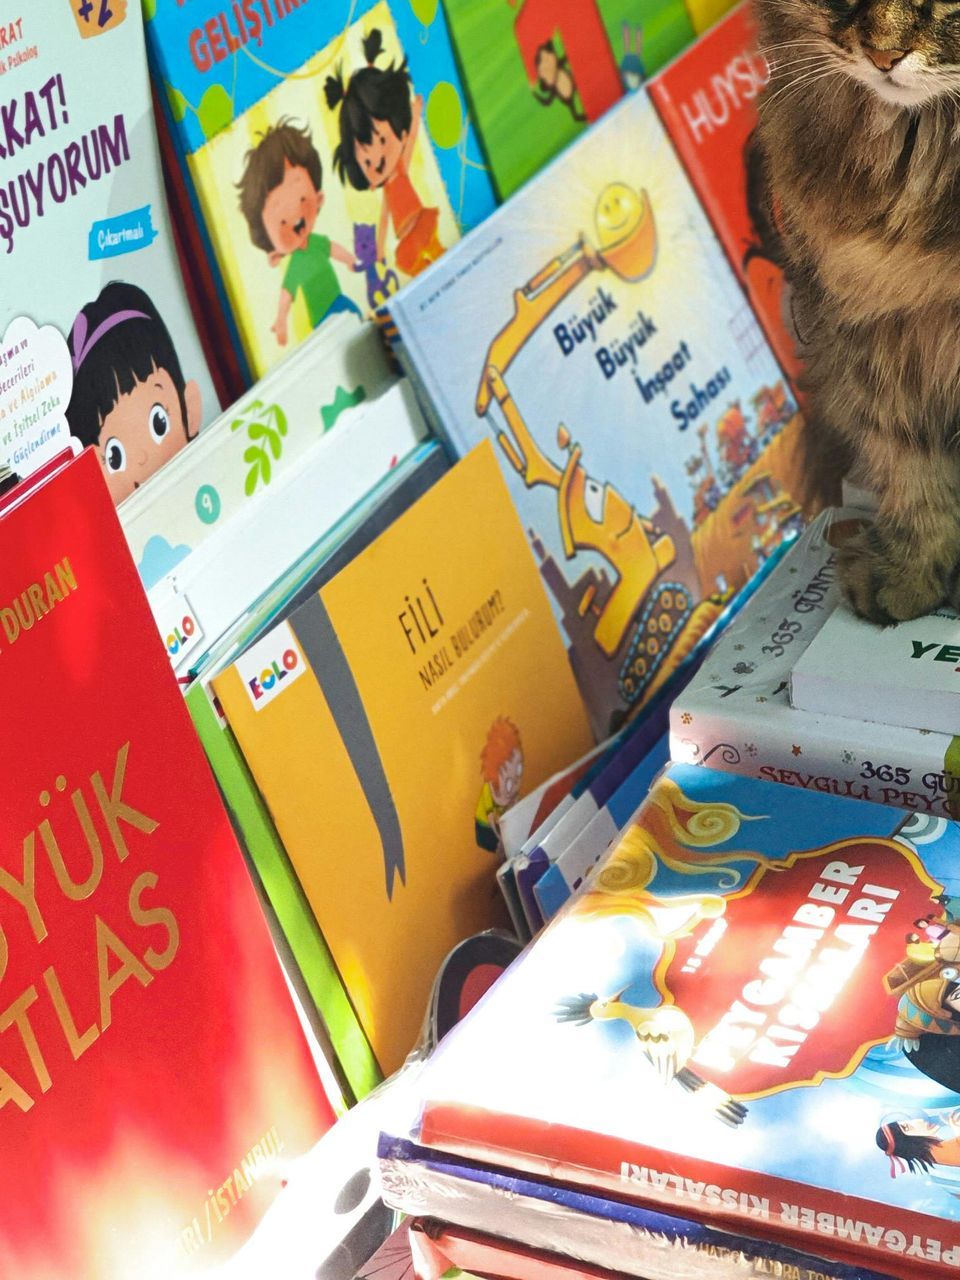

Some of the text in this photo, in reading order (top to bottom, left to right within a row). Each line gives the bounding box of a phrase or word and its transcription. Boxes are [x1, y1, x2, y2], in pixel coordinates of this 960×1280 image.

[98, 223, 144, 251] Çıkartmalı
[553, 286, 617, 357] Büyük
[595, 310, 658, 381] Büyük
[631, 340, 691, 404] İnşaat
[671, 366, 731, 431] Sahası
[0, 557, 77, 644] DURAN
[399, 578, 444, 654] FİLİ
[419, 646, 453, 691] NASIL
[762, 617, 802, 658] 365
[248, 649, 299, 701] EOLO
[860, 761, 912, 786] 365
[0, 740, 160, 982] YÜK
[620, 1161, 770, 1218] KISSALARI
